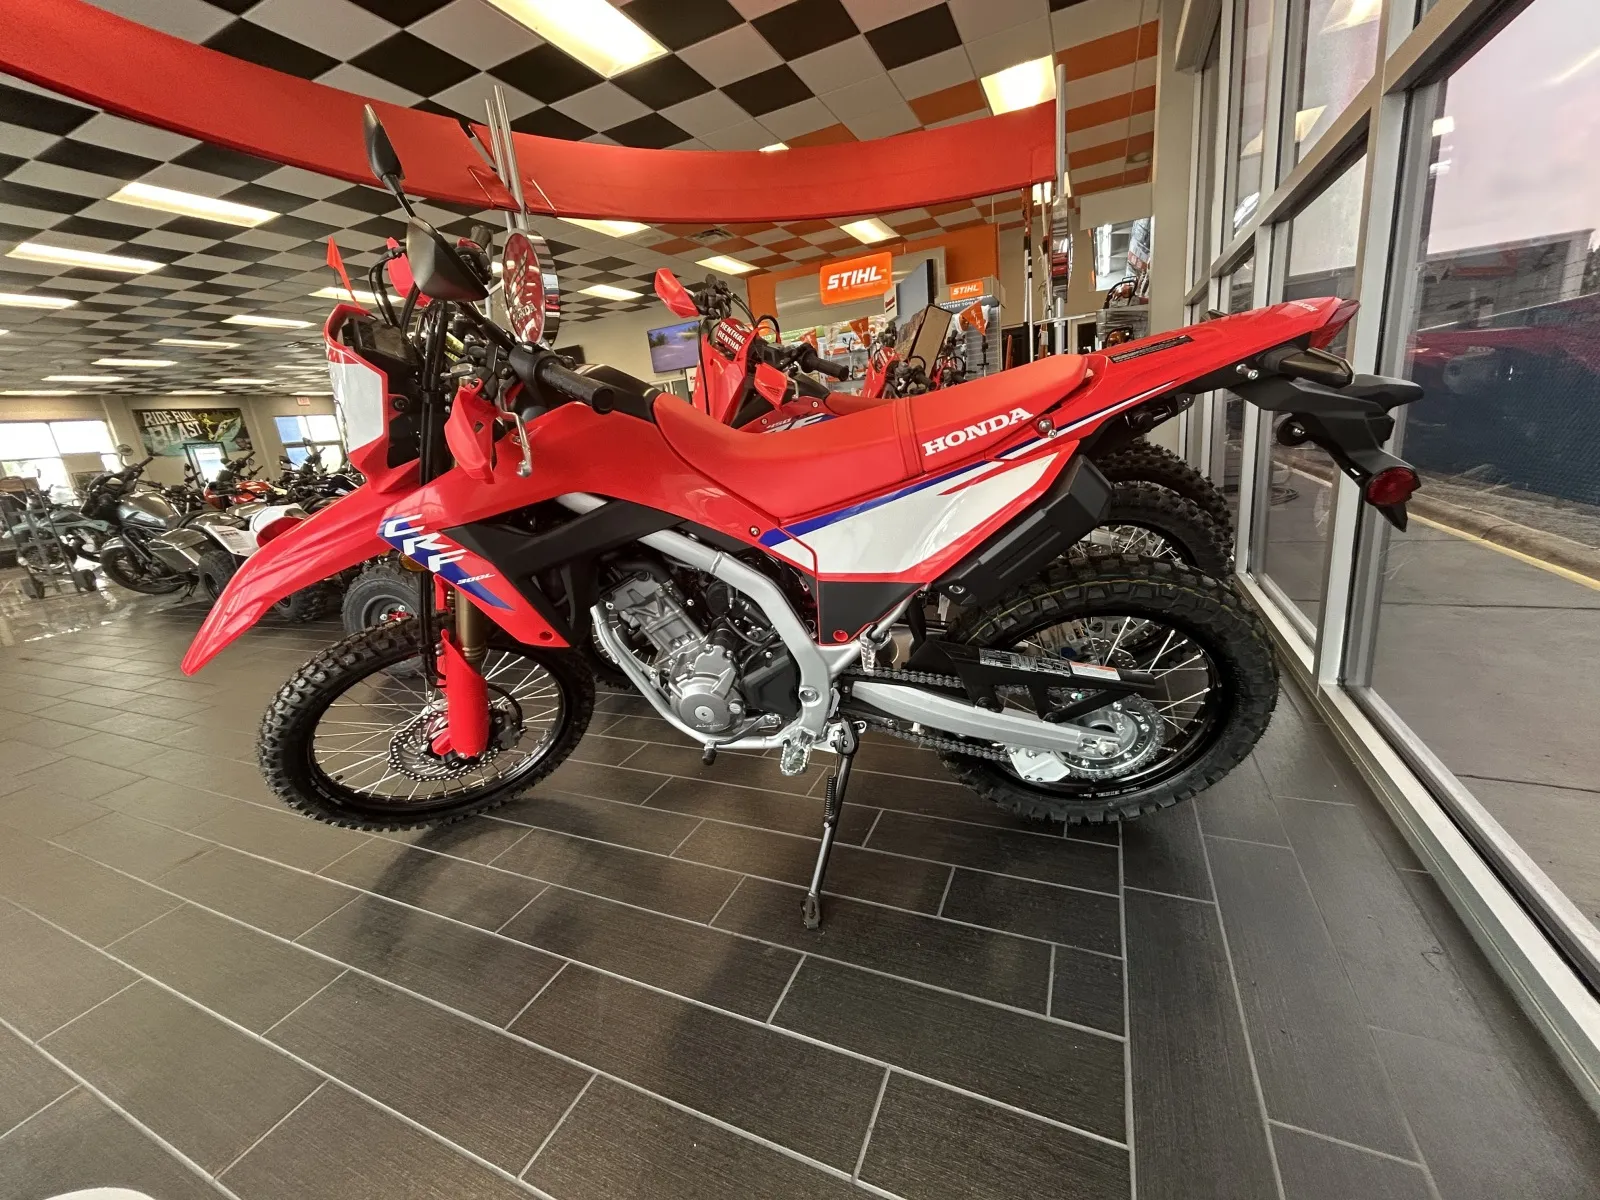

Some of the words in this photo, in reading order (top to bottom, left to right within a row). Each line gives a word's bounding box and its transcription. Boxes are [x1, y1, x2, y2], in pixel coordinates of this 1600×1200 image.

[827, 266, 882, 290] STIHL
[953, 285, 979, 295] STIHL
[720, 321, 746, 345] RENTHAL
[142, 411, 176, 427] RIDE
[171, 410, 197, 423] FULL
[146, 420, 203, 453] BLAST
[922, 407, 1034, 457] HONDA
[384, 513, 467, 573] CRF
[456, 573, 496, 585] 300L
